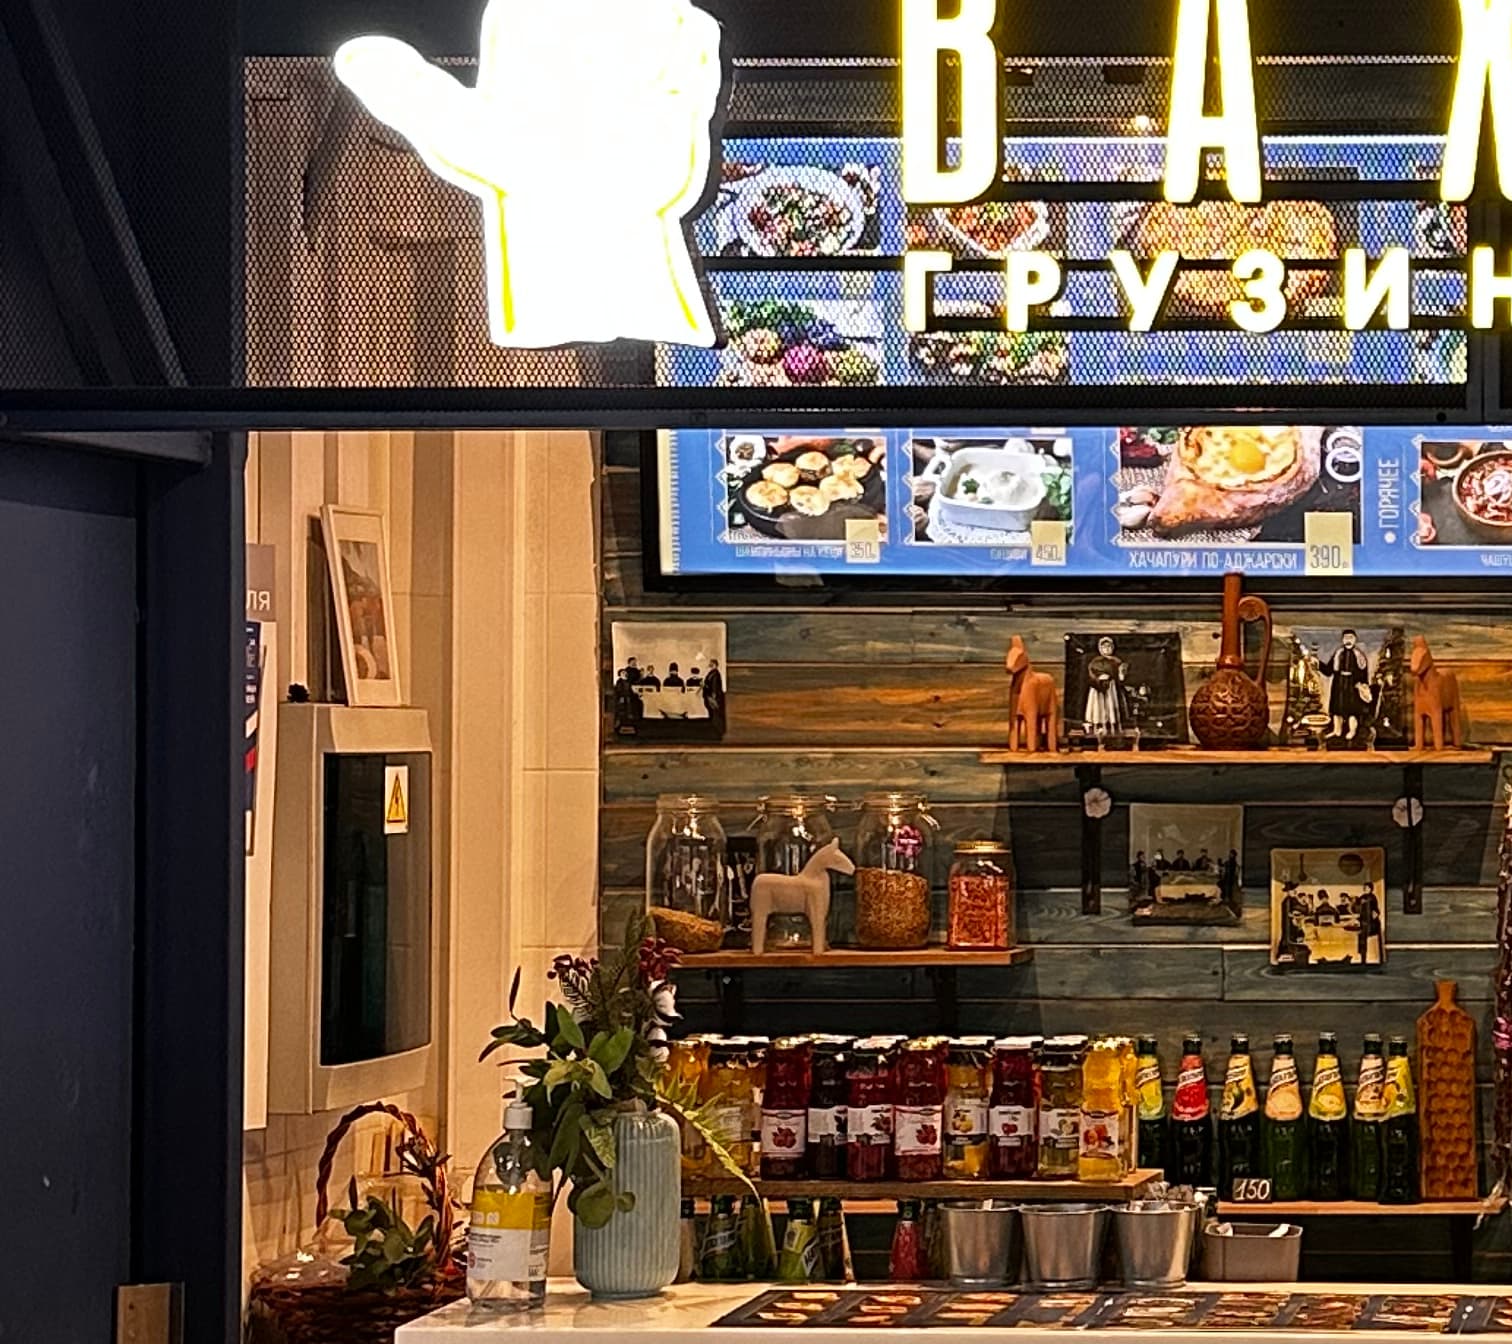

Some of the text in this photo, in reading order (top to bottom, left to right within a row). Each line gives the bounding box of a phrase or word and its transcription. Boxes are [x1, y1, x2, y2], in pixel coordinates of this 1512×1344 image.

[1378, 457, 1400, 529] ГОРЯЧЕЕ
[1129, 551, 1296, 570] ХАЧАПУРИ ПО-АДЖАРСКИ
[1235, 1179, 1270, 1200] 150
